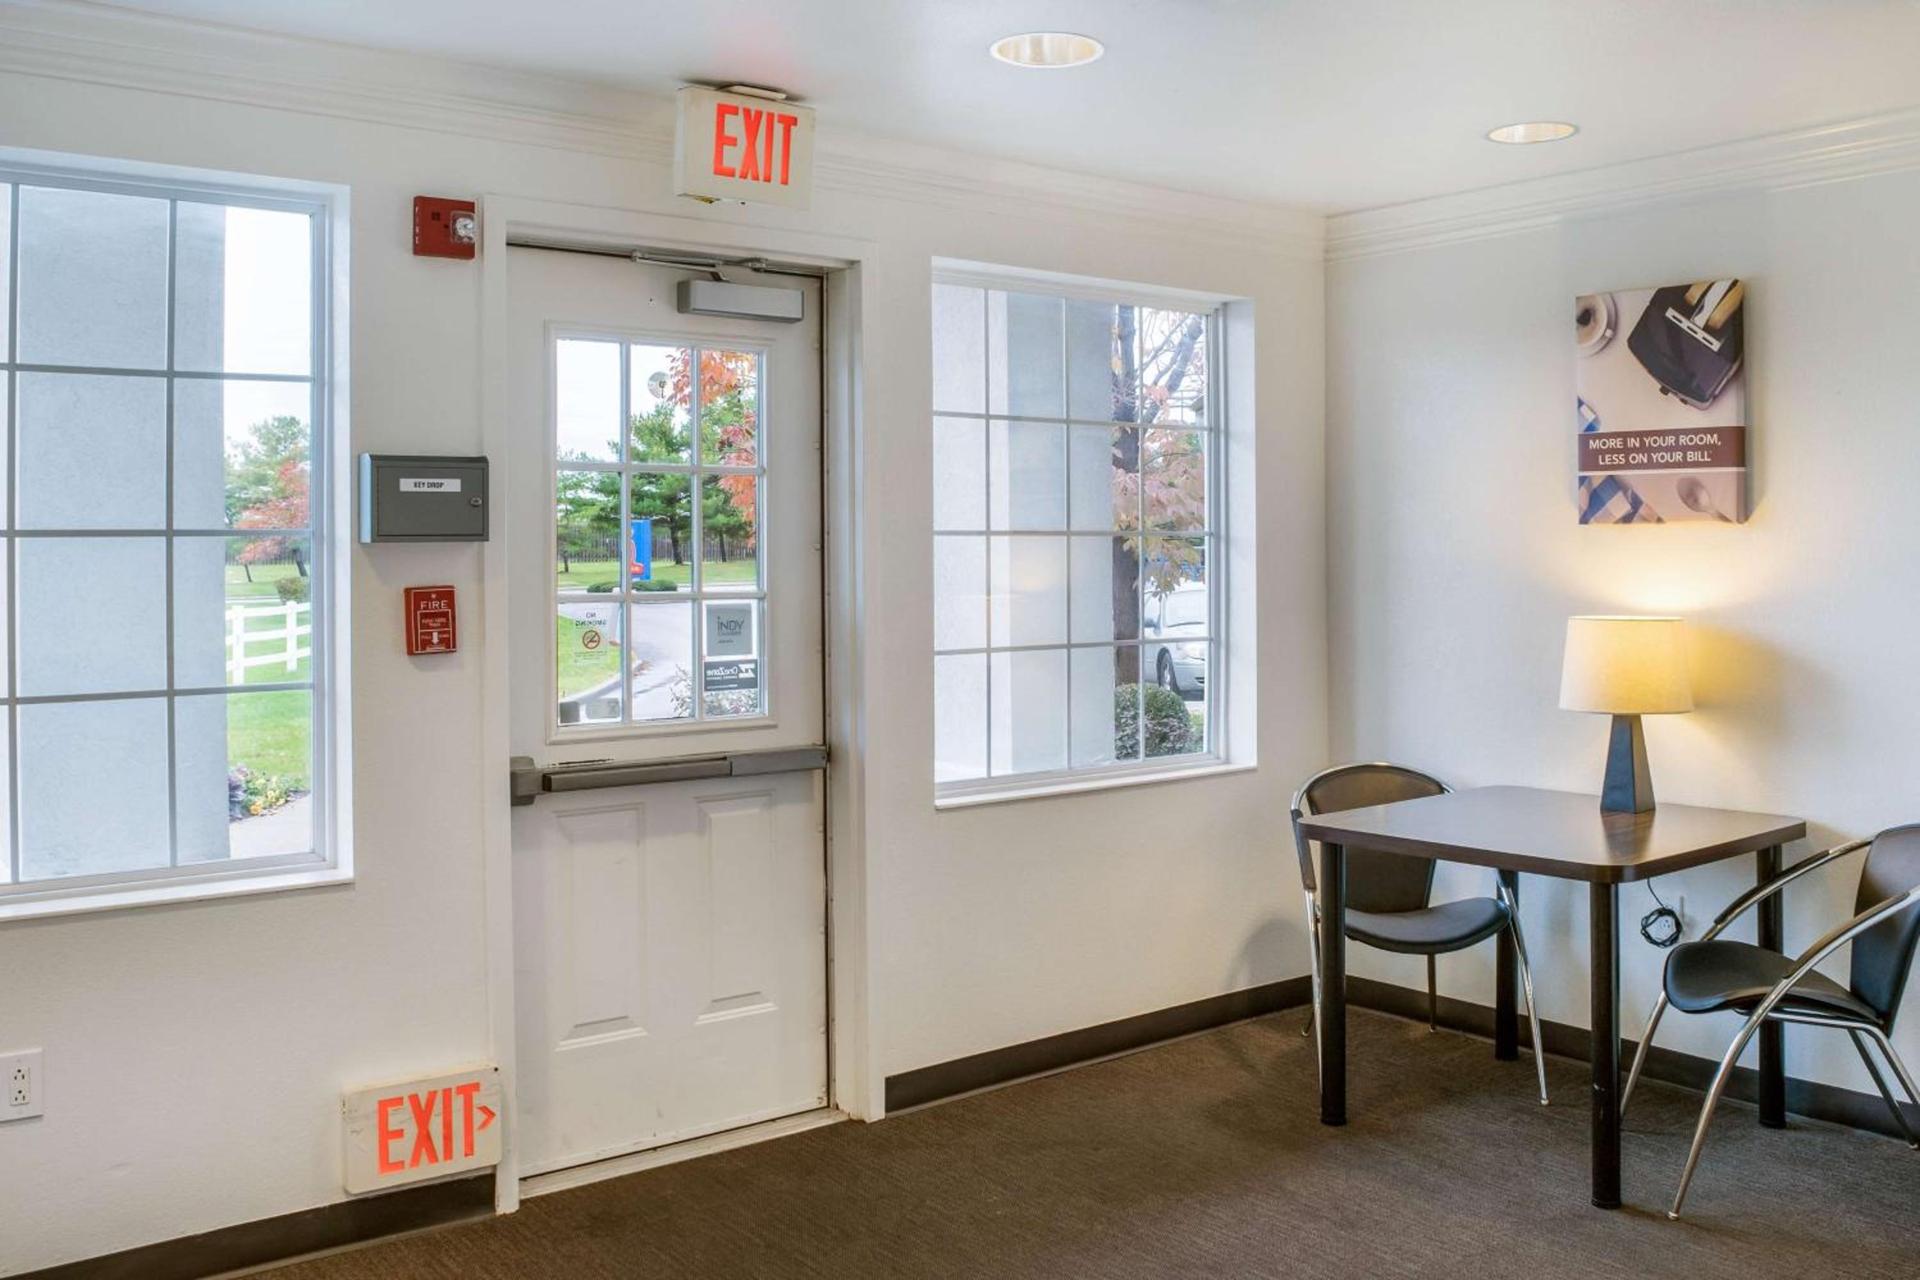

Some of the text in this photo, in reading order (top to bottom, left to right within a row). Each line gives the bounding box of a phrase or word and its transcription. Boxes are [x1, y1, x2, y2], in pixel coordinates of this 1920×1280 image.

[714, 103, 798, 185] EXIT
[1589, 433, 1722, 450] MORE IN YOUR ROOM,
[1598, 450, 1712, 465] LESS ON YOUR BILL
[413, 481, 445, 489] KEY DROP
[420, 600, 449, 610] FIRE
[377, 1082, 481, 1175] EXIT
